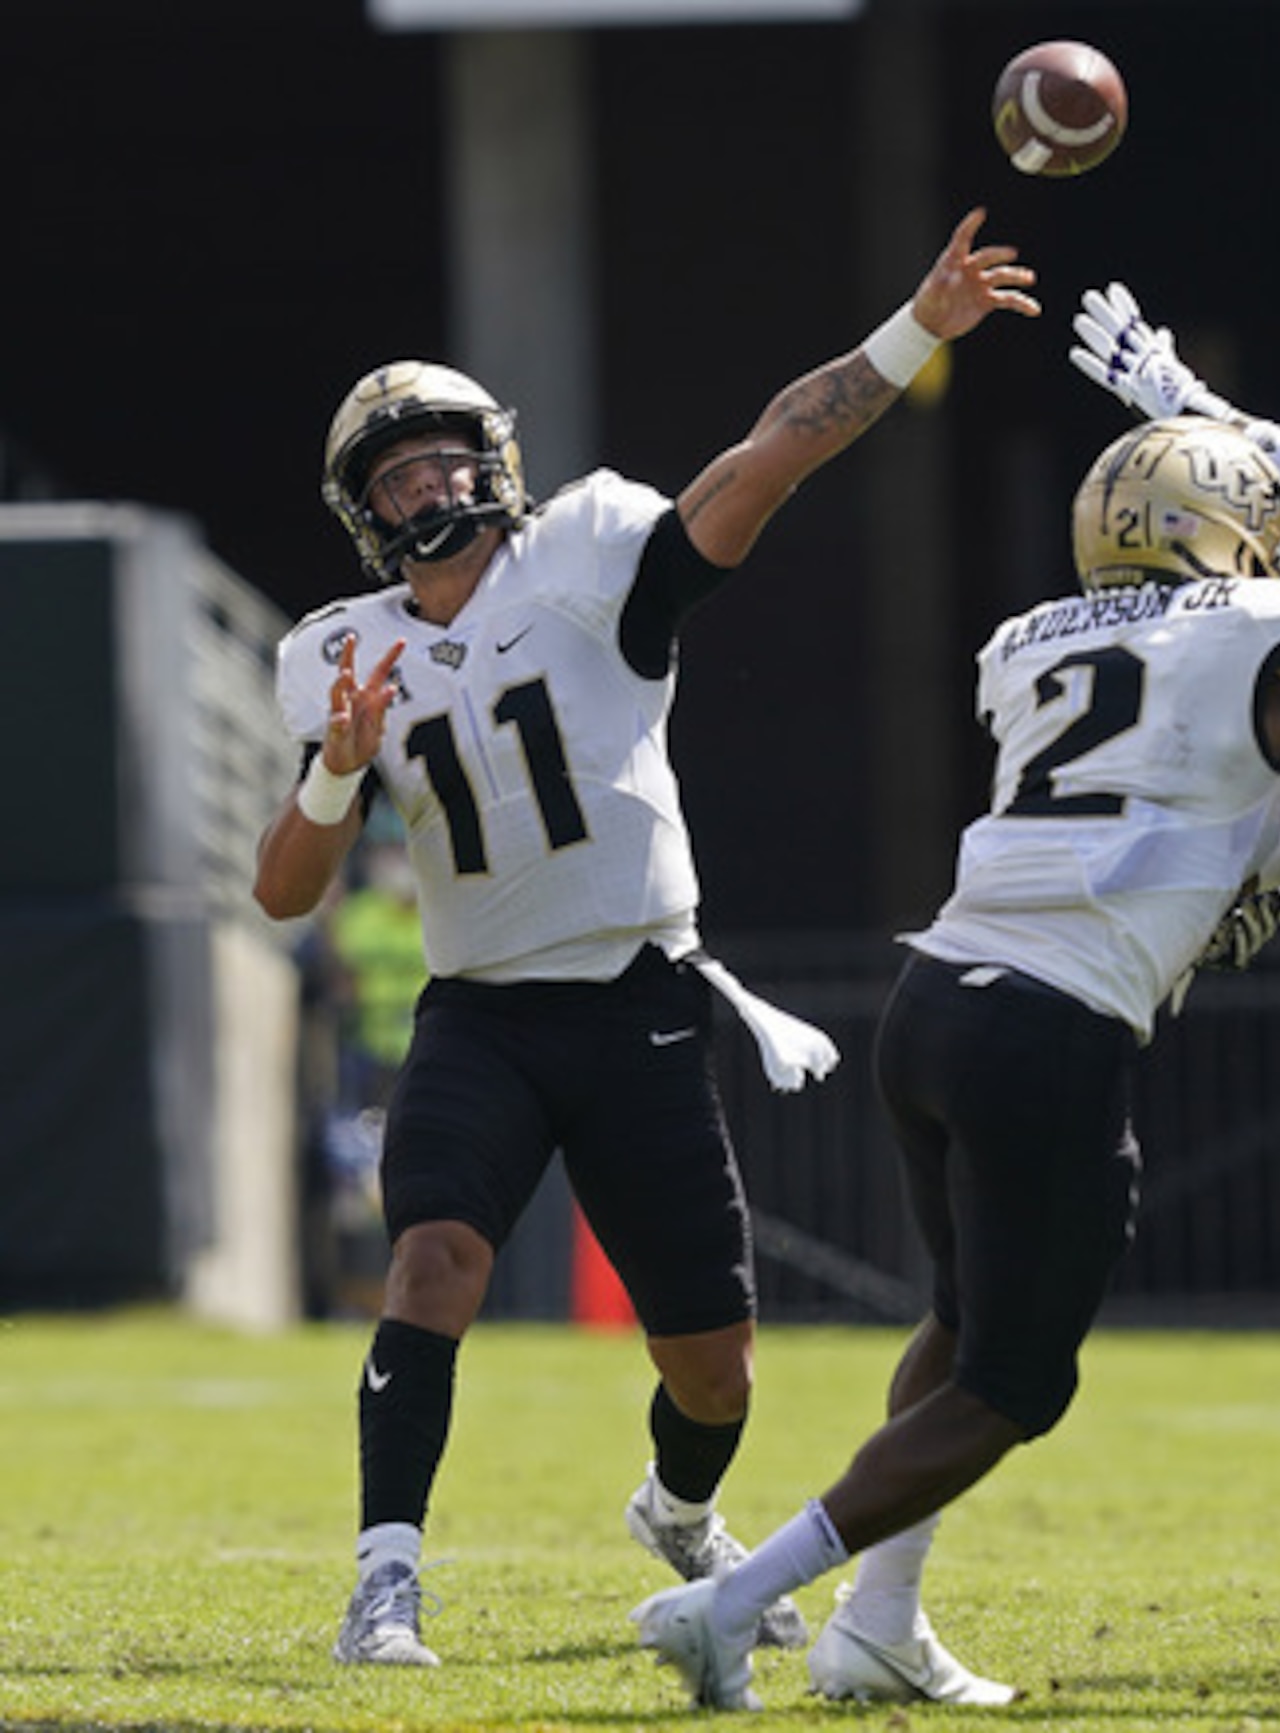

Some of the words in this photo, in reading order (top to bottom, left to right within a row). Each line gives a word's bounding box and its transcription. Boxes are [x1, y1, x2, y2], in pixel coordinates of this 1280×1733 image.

[1183, 578, 1238, 610] JR
[403, 669, 594, 881] 11
[998, 642, 1147, 820] 2
